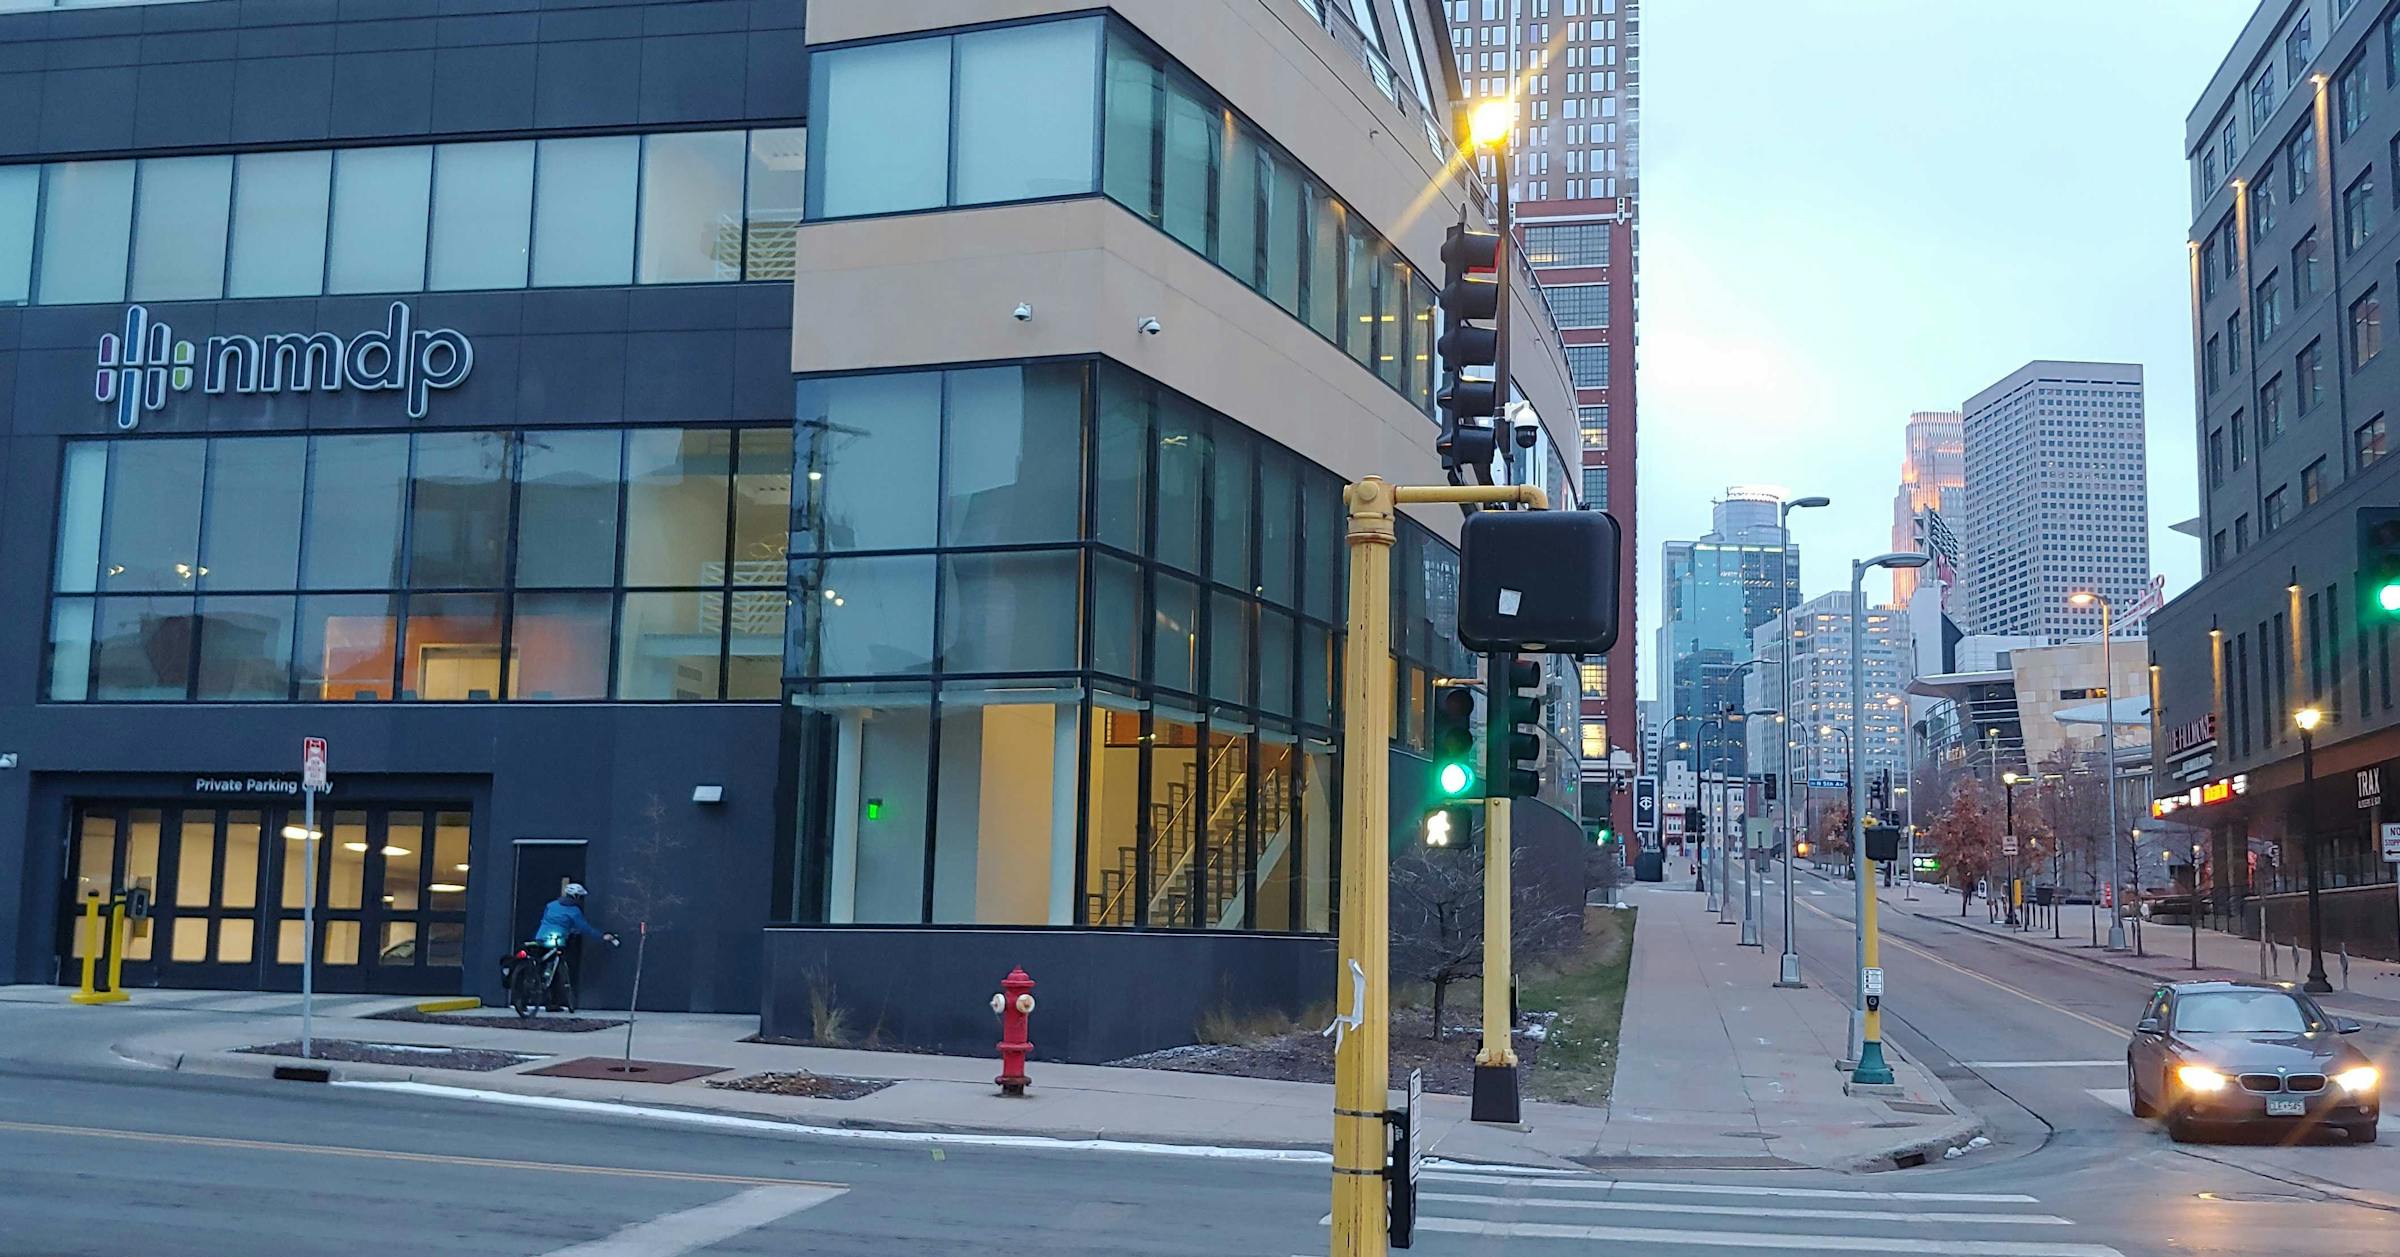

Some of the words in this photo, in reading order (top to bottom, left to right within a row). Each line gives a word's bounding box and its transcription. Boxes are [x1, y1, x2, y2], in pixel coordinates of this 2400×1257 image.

[204, 300, 473, 419] nmdp
[196, 778, 242, 792] Private
[247, 778, 297, 794] Parking
[2357, 768, 2380, 798] TRAX
